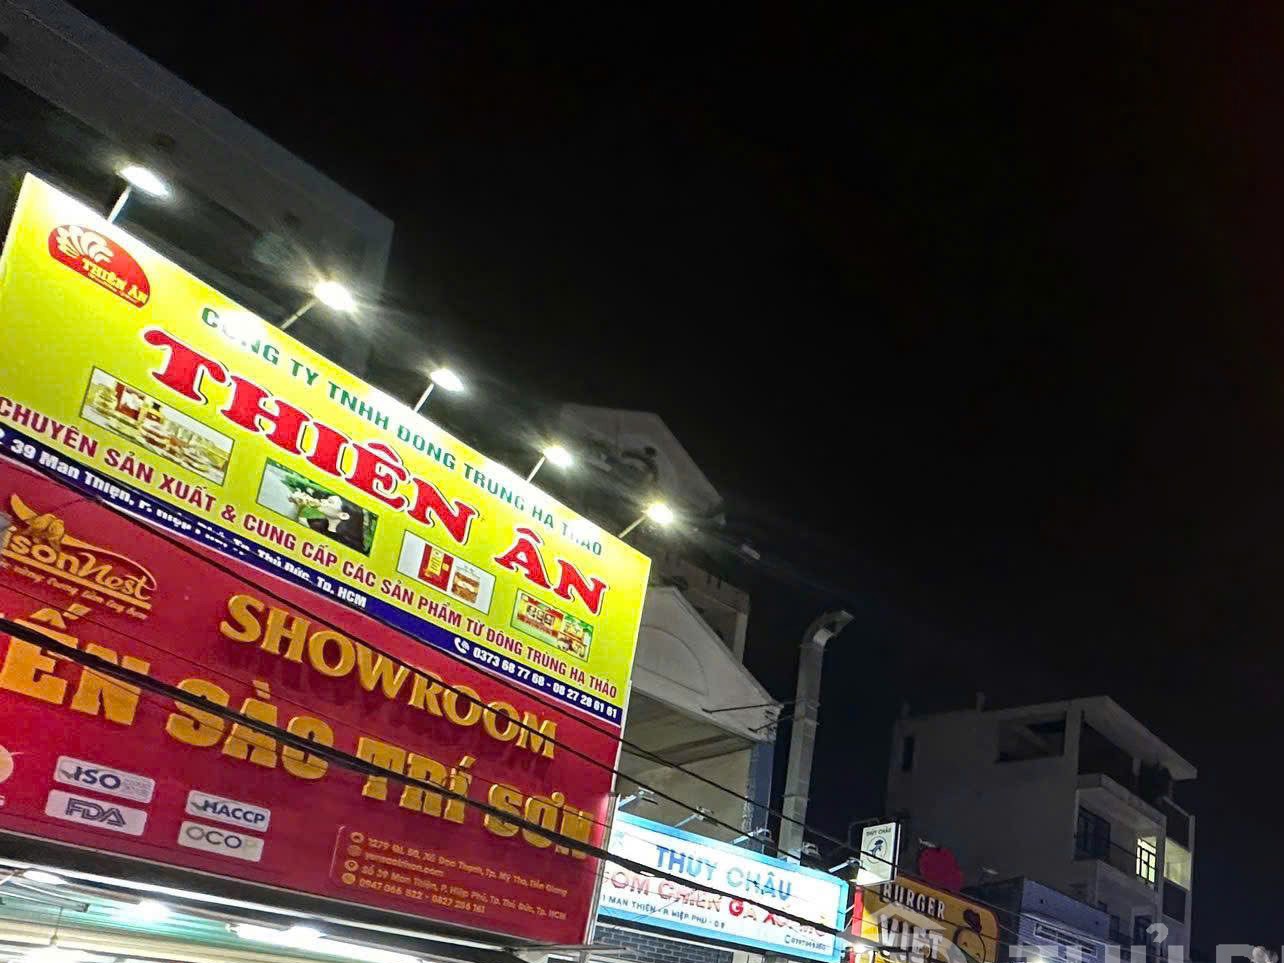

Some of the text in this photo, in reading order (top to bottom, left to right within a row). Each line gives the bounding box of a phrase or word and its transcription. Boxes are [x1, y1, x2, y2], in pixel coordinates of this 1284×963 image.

[290, 357, 319, 386] TY
[327, 380, 390, 431] TNHH
[143, 328, 608, 615] THIÊN ÂN
[0, 396, 99, 458] CHUYÊN
[103, 446, 155, 484] SẢN
[158, 472, 218, 513] XUẤT
[220, 504, 237, 524] &
[242, 514, 297, 551] CUNG
[300, 541, 339, 571] CẤP
[342, 559, 377, 588] CÁC
[380, 576, 417, 607] SẢN
[416, 595, 462, 628] PHẨM
[465, 617, 485, 637] TỪ
[485, 625, 524, 657] ĐÔNG
[526, 643, 568, 676] TRÙNG
[569, 667, 586, 690] HẠ
[588, 677, 619, 699] THẢO
[11, 438, 36, 460] 39
[39, 450, 79, 481] Man
[336, 584, 368, 610] HCM
[220, 593, 558, 760] SHOWROOM
[472, 646, 500, 668] 0373
[516, 664, 531, 681] 77
[566, 686, 580, 703] 27
[73, 766, 122, 790] ISO
[355, 736, 477, 825] TRÍ
[64, 797, 127, 828] FDA
[202, 799, 266, 826] HACCP
[725, 864, 793, 902] CHÂU
[881, 882, 946, 921] BURGER
